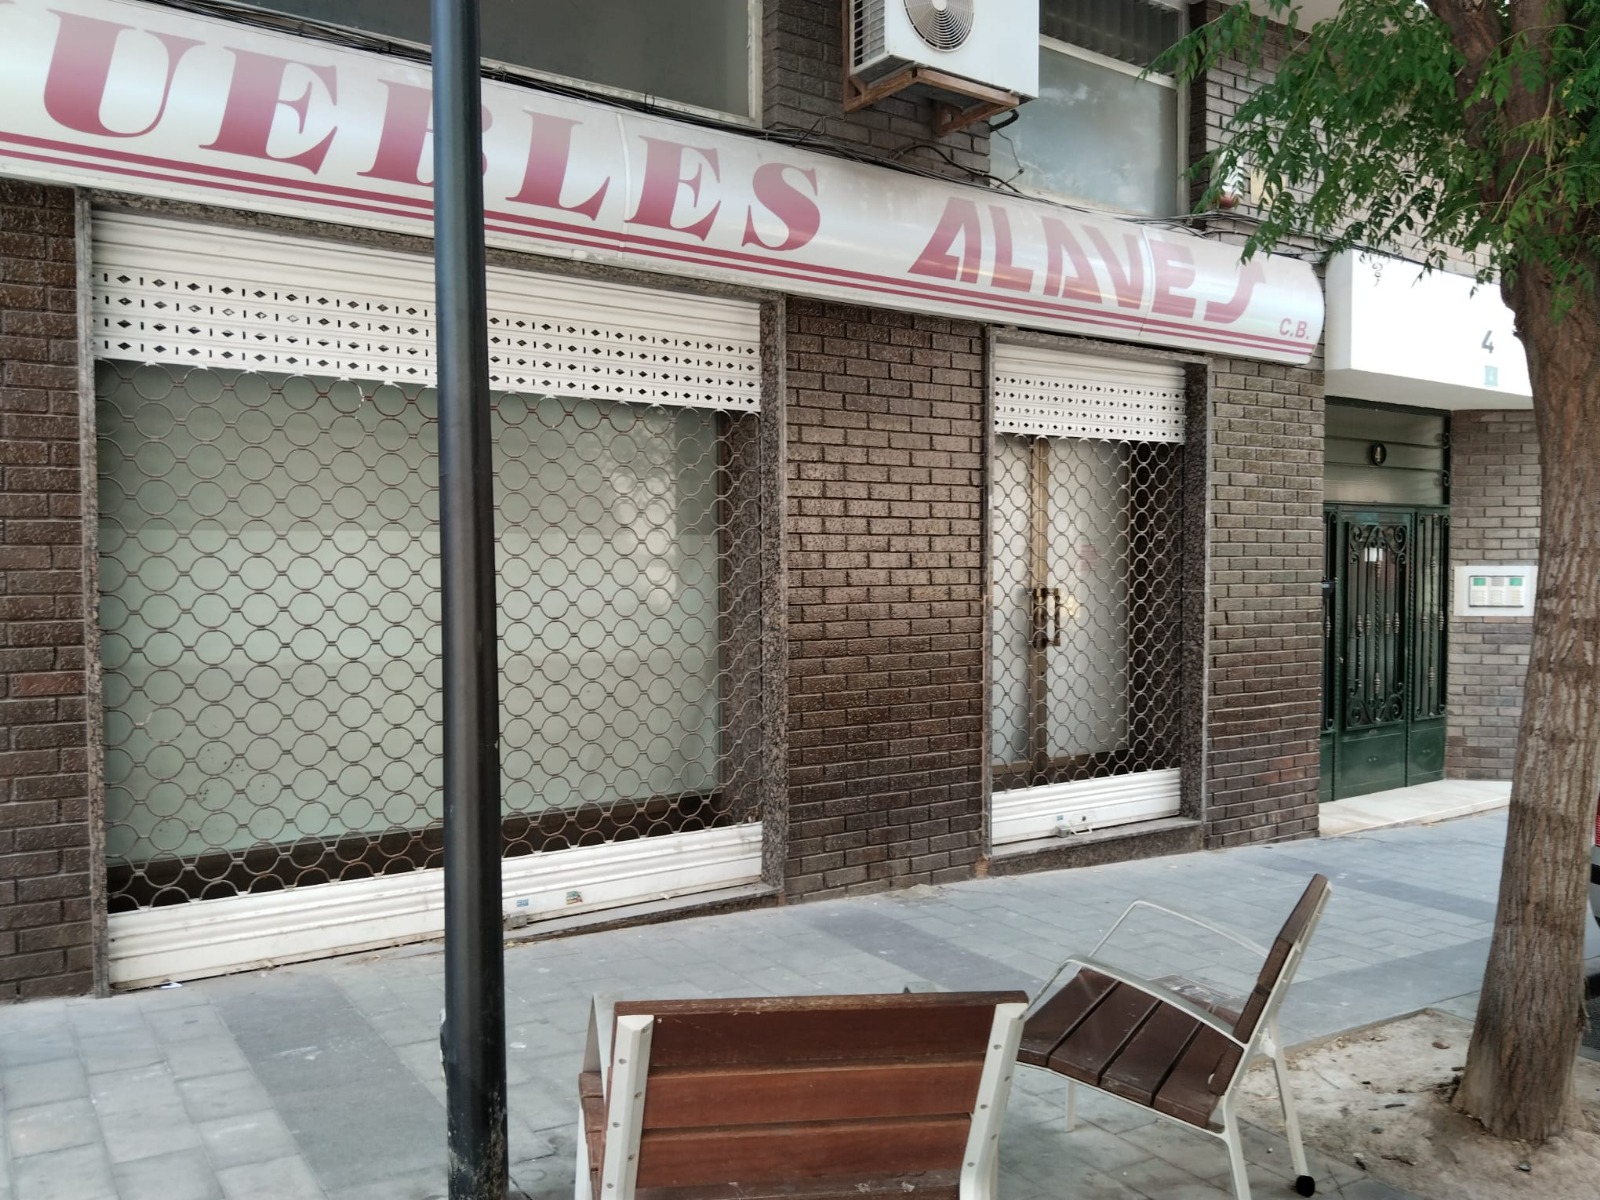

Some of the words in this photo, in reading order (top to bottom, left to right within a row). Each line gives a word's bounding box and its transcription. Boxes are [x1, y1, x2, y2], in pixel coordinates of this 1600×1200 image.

[0, 0, 821, 251] UEBLES
[1279, 317, 1309, 340] C.B.
[1481, 330, 1494, 354] 4
